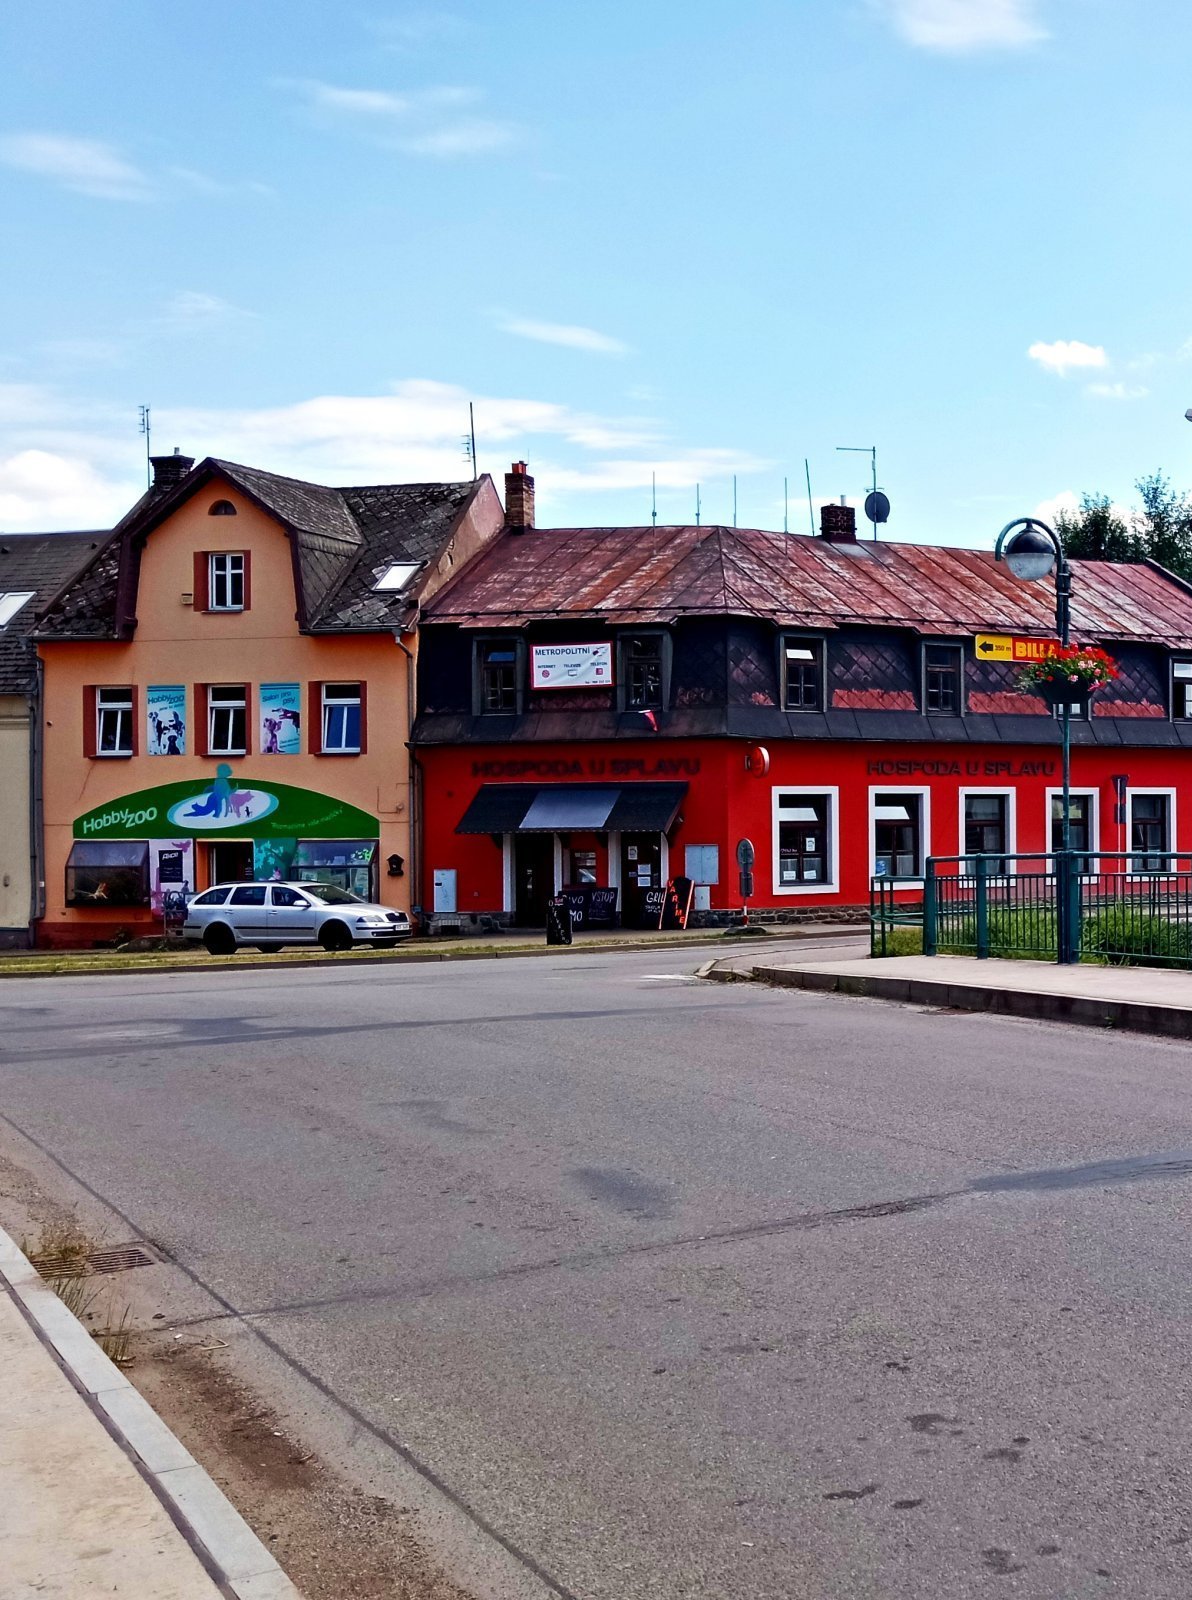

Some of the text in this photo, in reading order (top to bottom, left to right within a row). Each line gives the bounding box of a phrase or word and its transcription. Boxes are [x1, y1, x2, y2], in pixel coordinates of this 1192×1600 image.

[535, 646, 590, 656] METROPOLITNÍ
[1015, 641, 1057, 659] BILLA
[472, 758, 700, 776] HOSPODA U SPLAVU
[867, 759, 1056, 776] HOSPODA U SPLAVU
